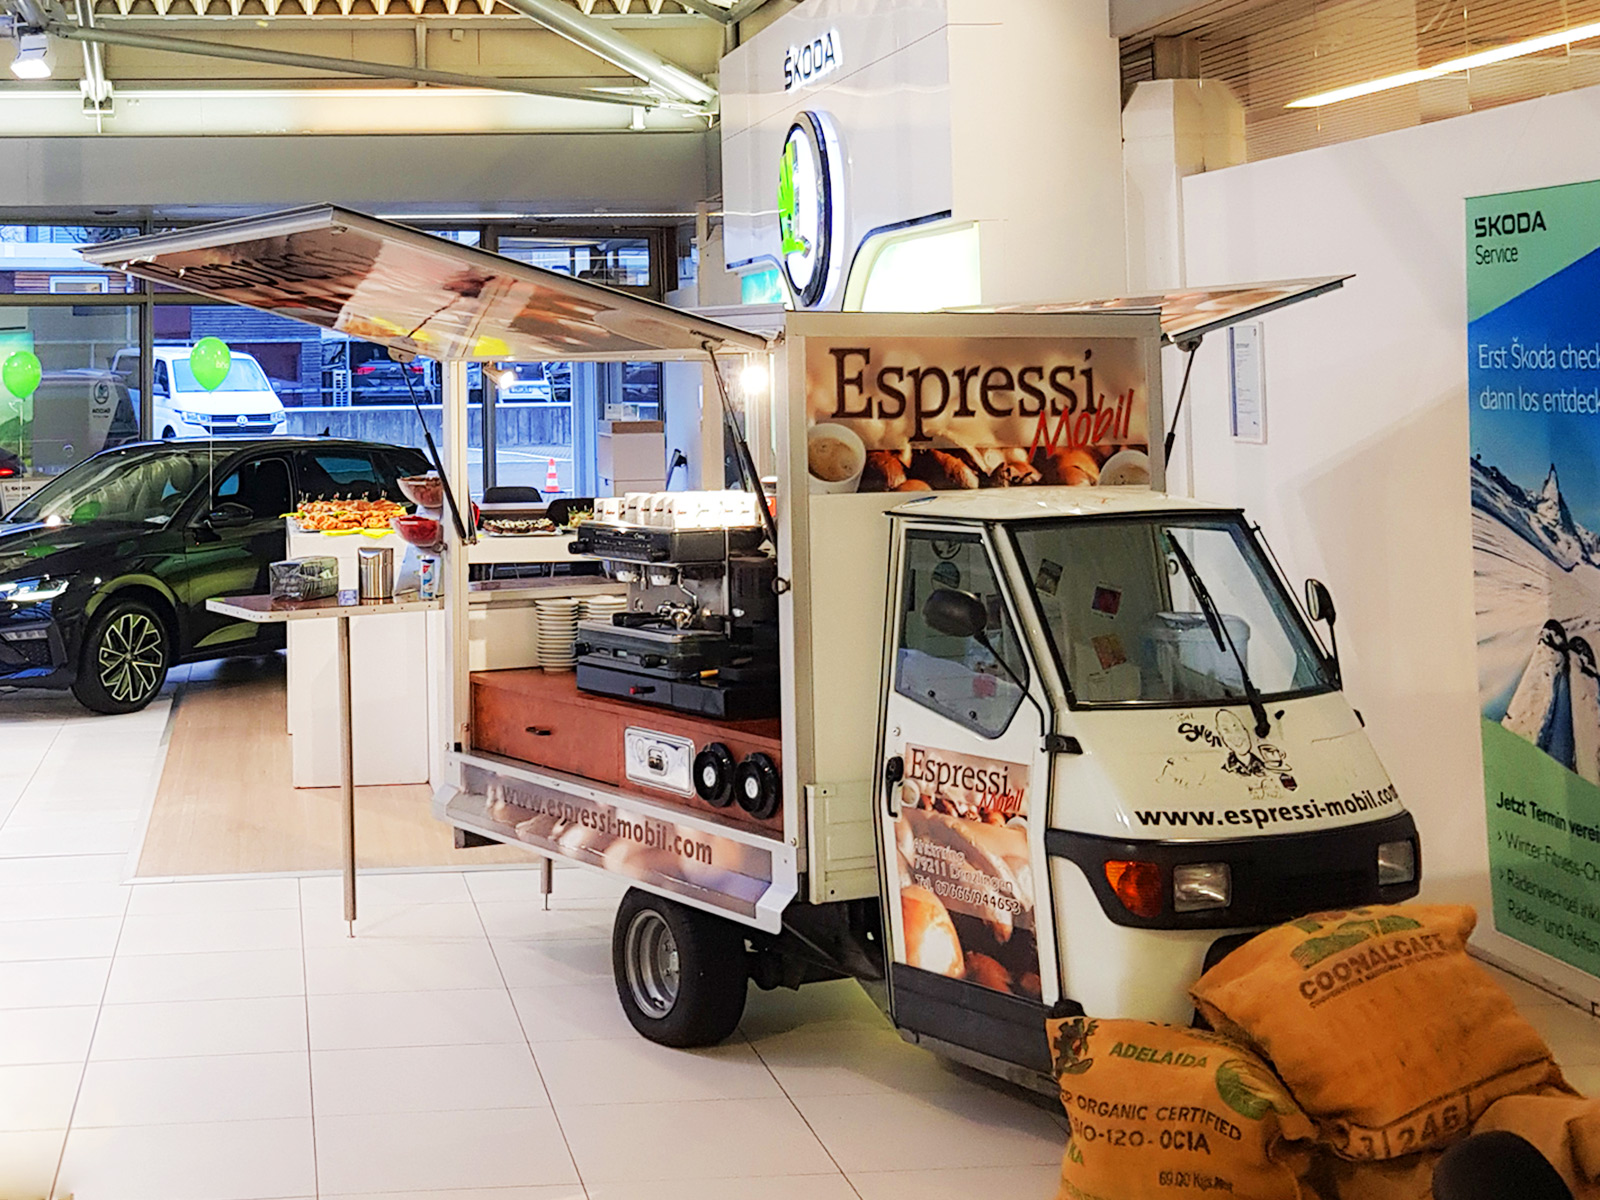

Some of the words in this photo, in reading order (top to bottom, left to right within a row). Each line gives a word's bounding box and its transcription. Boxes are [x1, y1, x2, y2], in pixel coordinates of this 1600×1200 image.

[1475, 245, 1519, 265] Service
[1478, 344, 1508, 369] Erst
[1511, 336, 1556, 369] Škoda
[829, 347, 1100, 442] Espressi
[1480, 385, 1515, 410] dann
[1519, 385, 1539, 411] los
[1028, 388, 1134, 464] Mobil
[1178, 722, 1222, 747] Sven
[909, 748, 1010, 797] Espressi
[502, 784, 712, 865] www.espressi-mobil.com
[1496, 792, 1526, 816] Jetzt
[1529, 801, 1566, 831] Termin
[914, 855, 947, 877] 79211
[1109, 1041, 1209, 1068] ADELAIDA
[1077, 1095, 1148, 1121] ORGANIC
[1156, 1106, 1242, 1141] CERTIFIED
